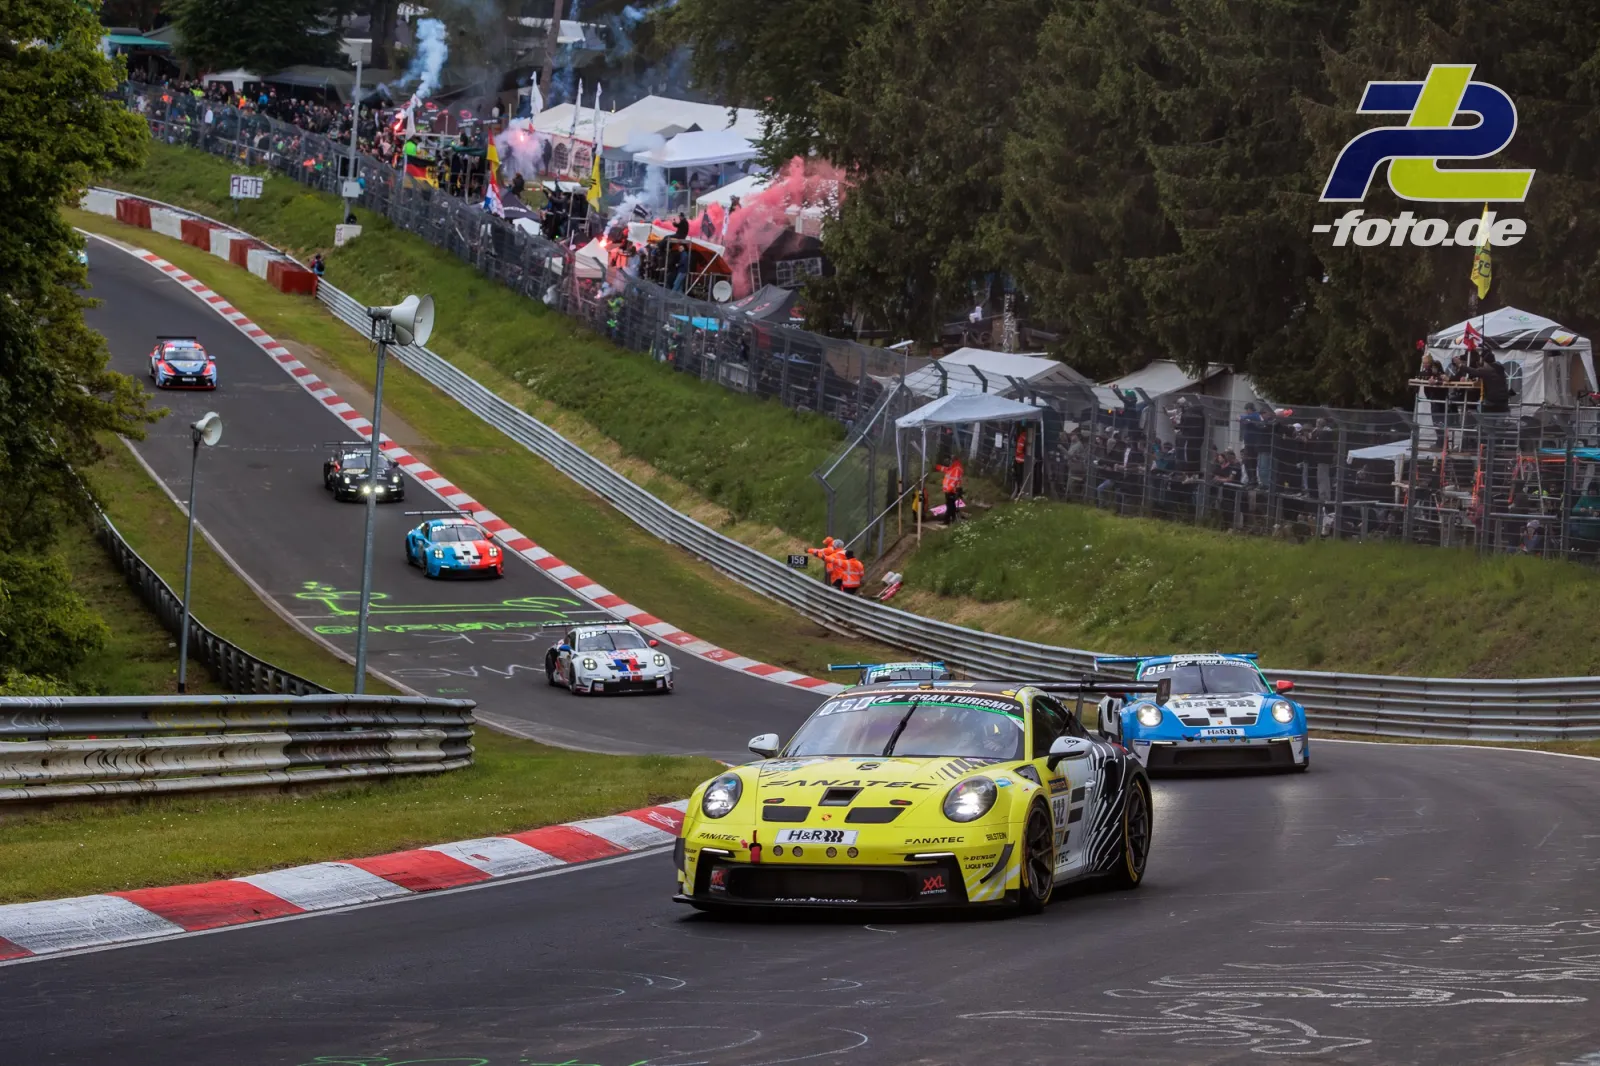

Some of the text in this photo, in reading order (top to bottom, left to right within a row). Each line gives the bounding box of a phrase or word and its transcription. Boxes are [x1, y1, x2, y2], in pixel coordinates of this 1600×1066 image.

[791, 555, 805, 565] 158
[1146, 661, 1177, 676] 051
[1219, 660, 1252, 668] TURISMO
[819, 696, 876, 716] 050
[908, 694, 949, 702] GRAN
[950, 695, 1014, 711] TURISMO
[761, 779, 938, 790] FANATEC
[699, 832, 740, 842] FANATEC
[788, 829, 823, 842] H&R
[904, 836, 964, 845] FANATEC
[923, 875, 946, 891] XXL
